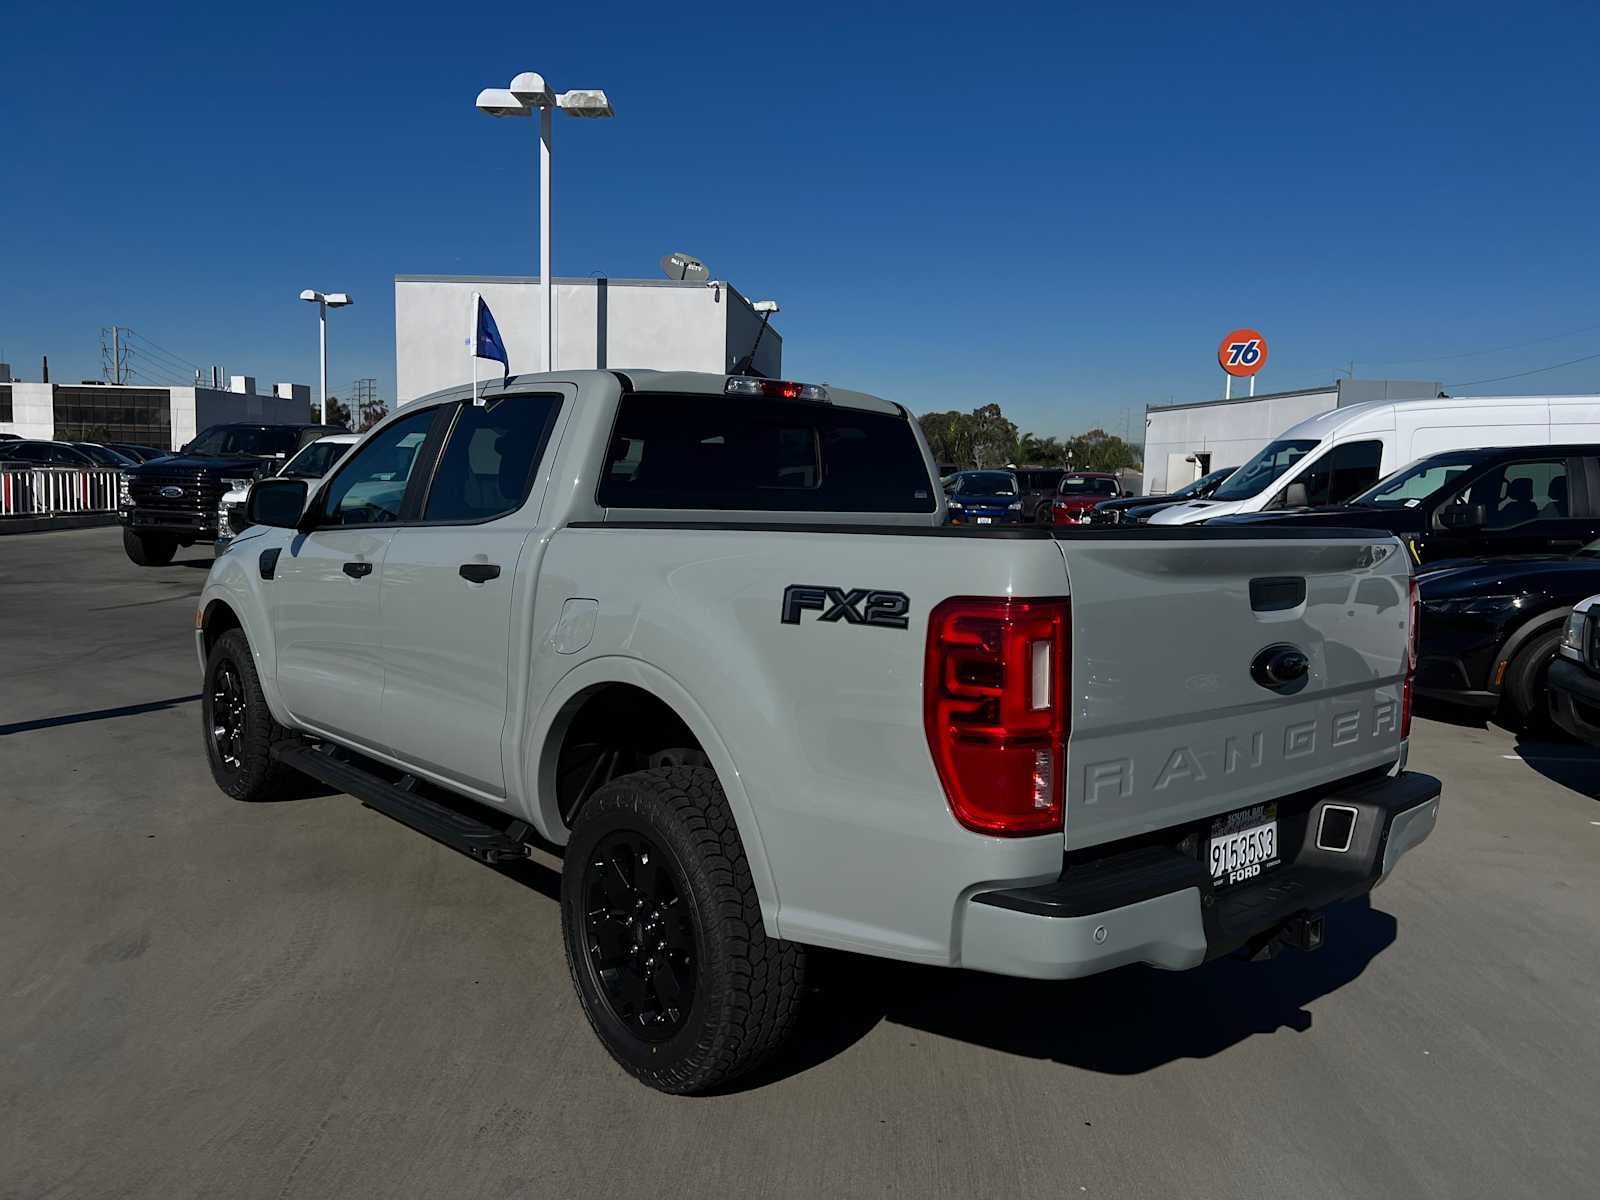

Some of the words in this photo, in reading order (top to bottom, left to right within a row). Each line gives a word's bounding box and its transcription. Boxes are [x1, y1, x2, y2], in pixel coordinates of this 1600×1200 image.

[1226, 339, 1261, 366] 76
[781, 584, 910, 630] FX2
[1083, 702, 1397, 804] RANGER
[1212, 828, 1274, 878] 91535S3
[1229, 864, 1261, 885] FORD
